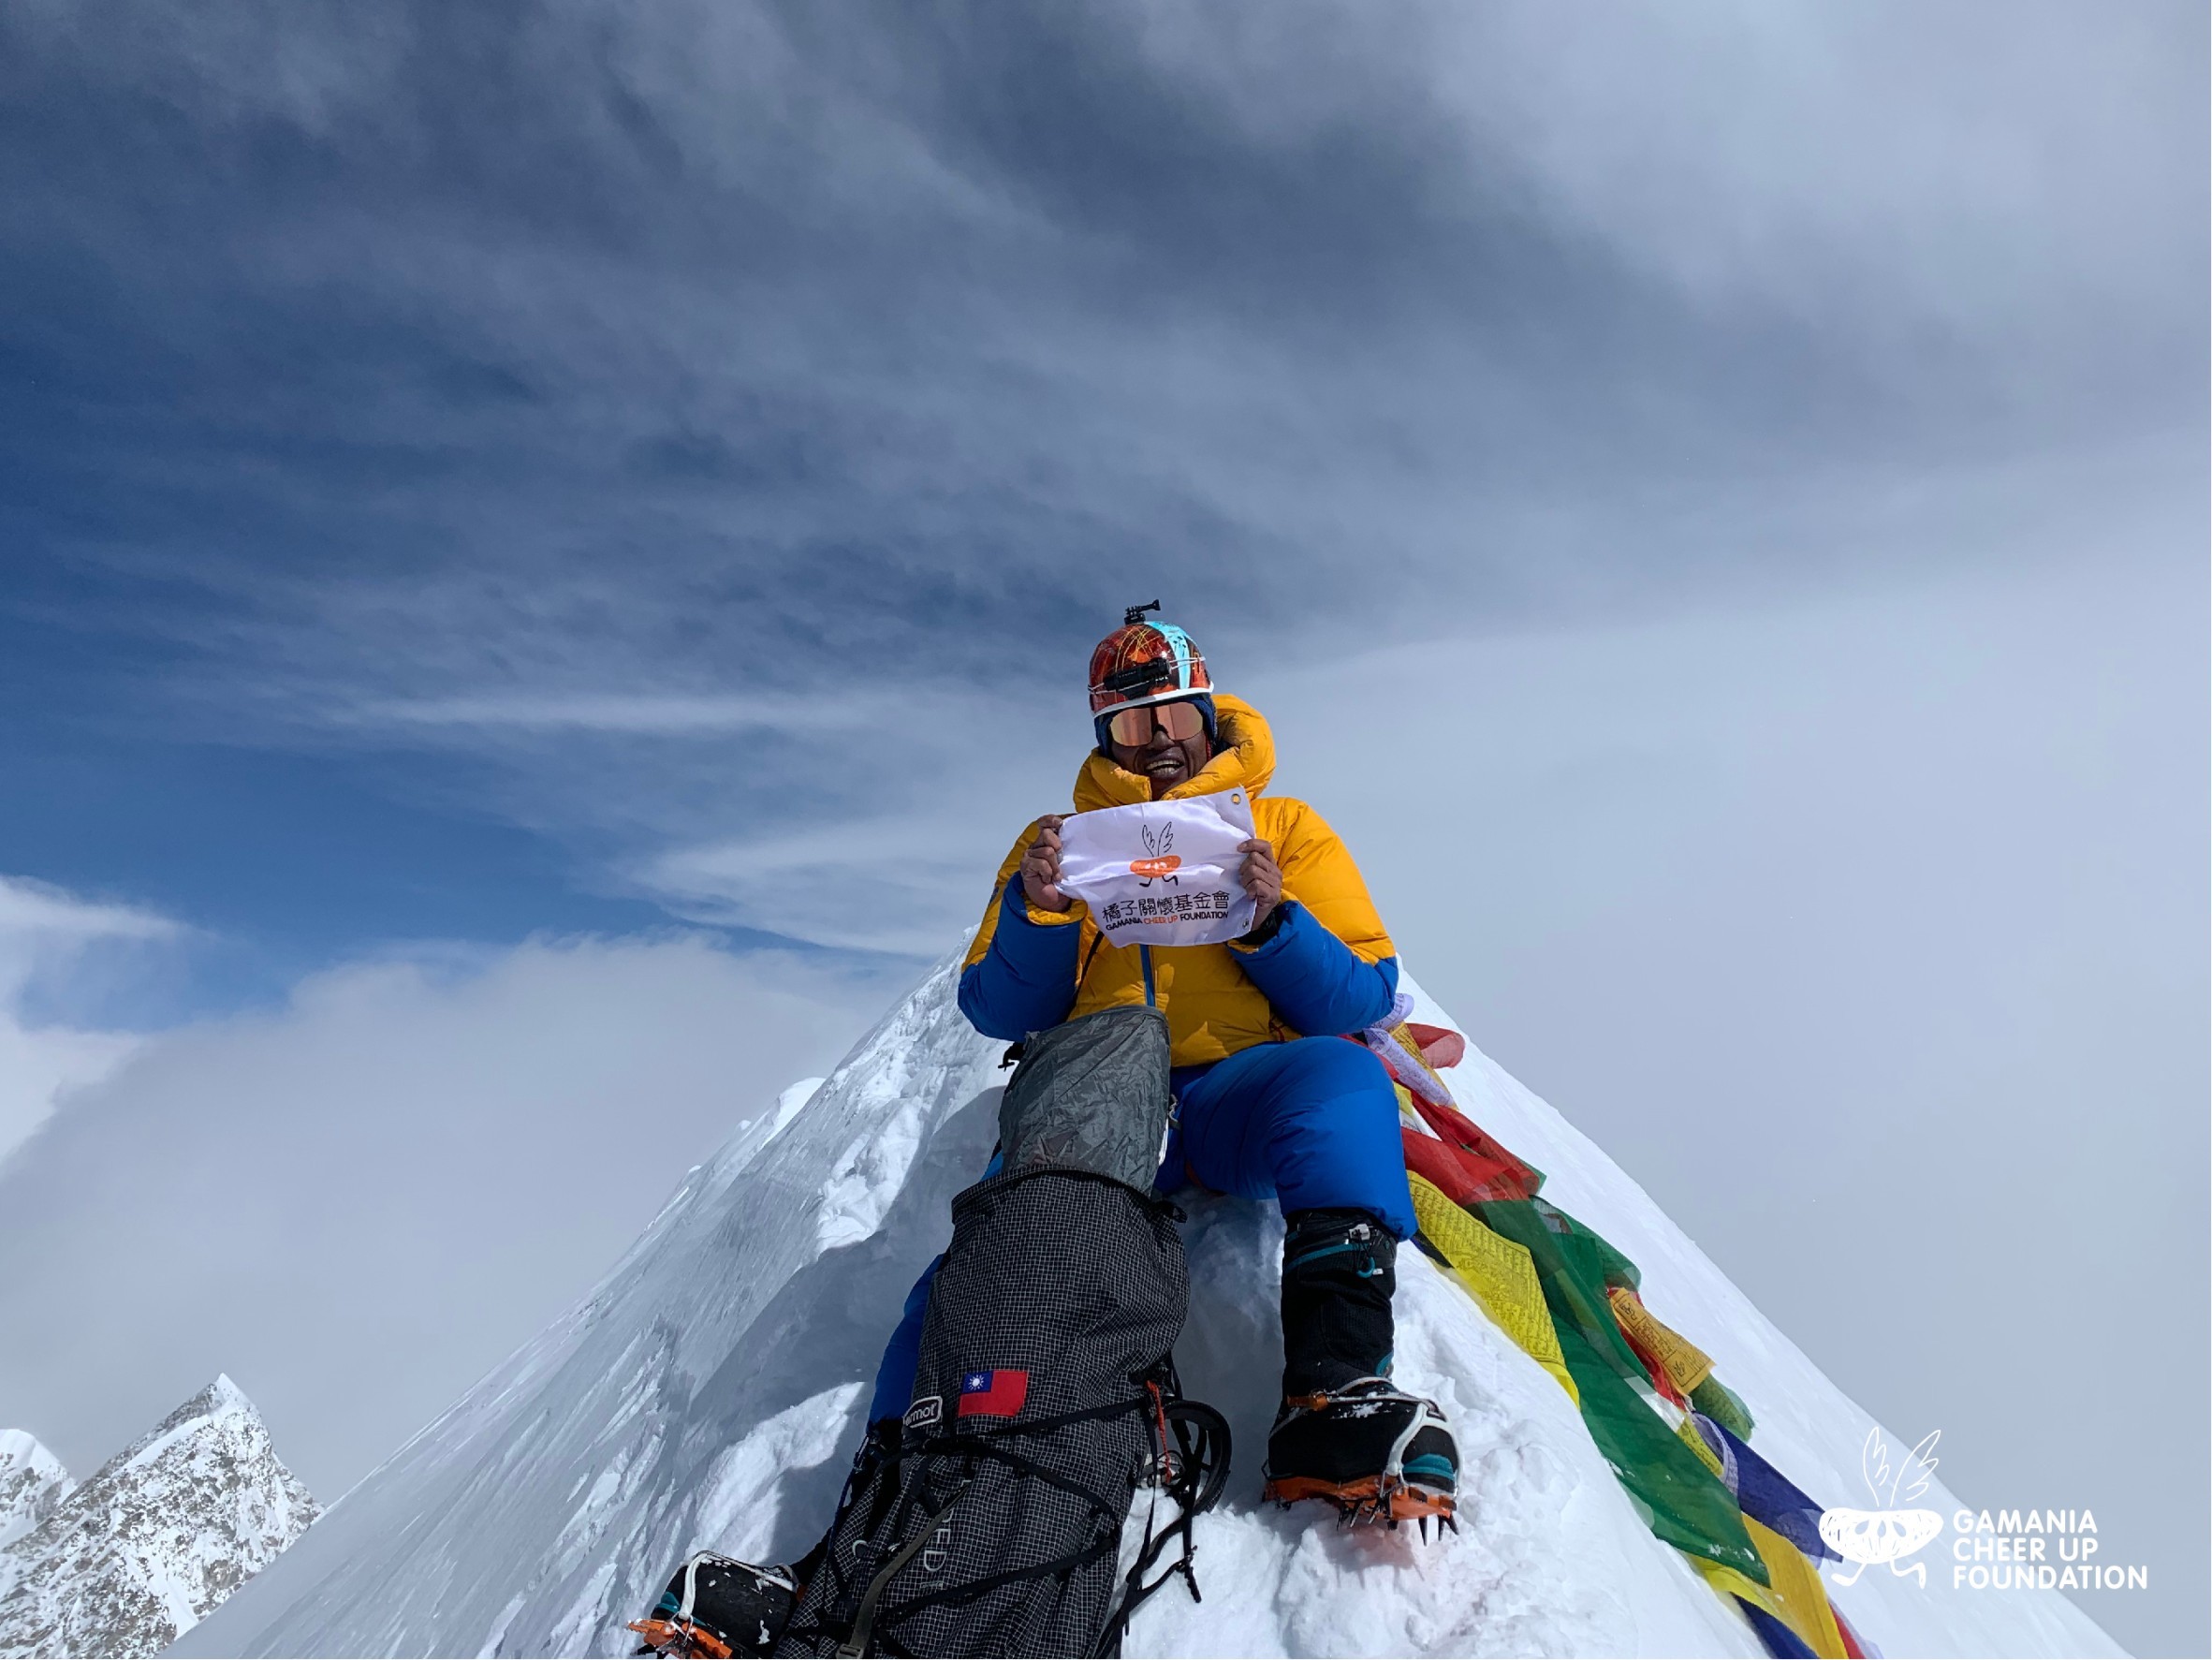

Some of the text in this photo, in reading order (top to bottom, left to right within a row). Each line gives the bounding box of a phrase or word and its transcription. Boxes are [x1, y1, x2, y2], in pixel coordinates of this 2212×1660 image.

[1102, 889, 1230, 923] 橘子關懷基金會
[1106, 911, 1229, 931] GAMANIA CHEER UP FOUNDATION
[904, 1402, 937, 1426] armot
